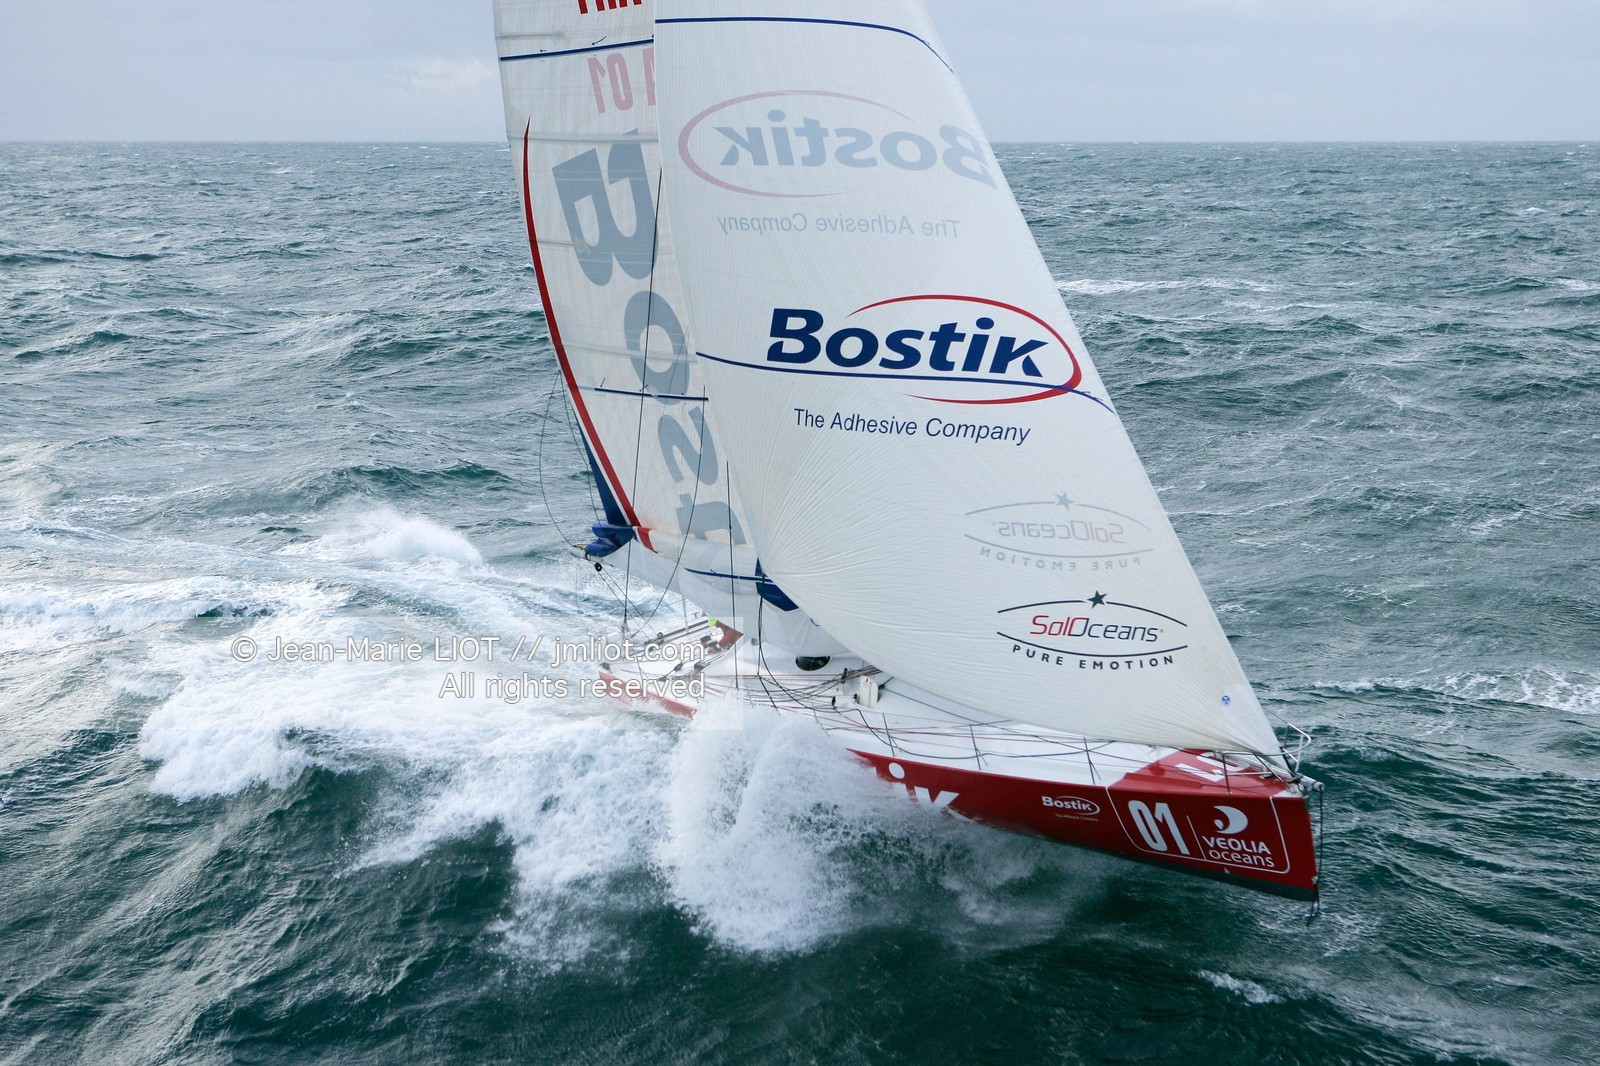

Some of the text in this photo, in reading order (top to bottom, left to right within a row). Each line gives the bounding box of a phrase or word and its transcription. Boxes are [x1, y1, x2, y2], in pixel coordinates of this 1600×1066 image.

[766, 308, 1049, 377] Bostik
[794, 408, 1031, 446] The Adhesive Company
[1029, 614, 1159, 642] SolOceans
[1012, 644, 1174, 670] PURE EMOTION
[1041, 795, 1093, 811] Bostik
[1128, 800, 1190, 855] 01
[1202, 835, 1272, 855] VEOLIA
